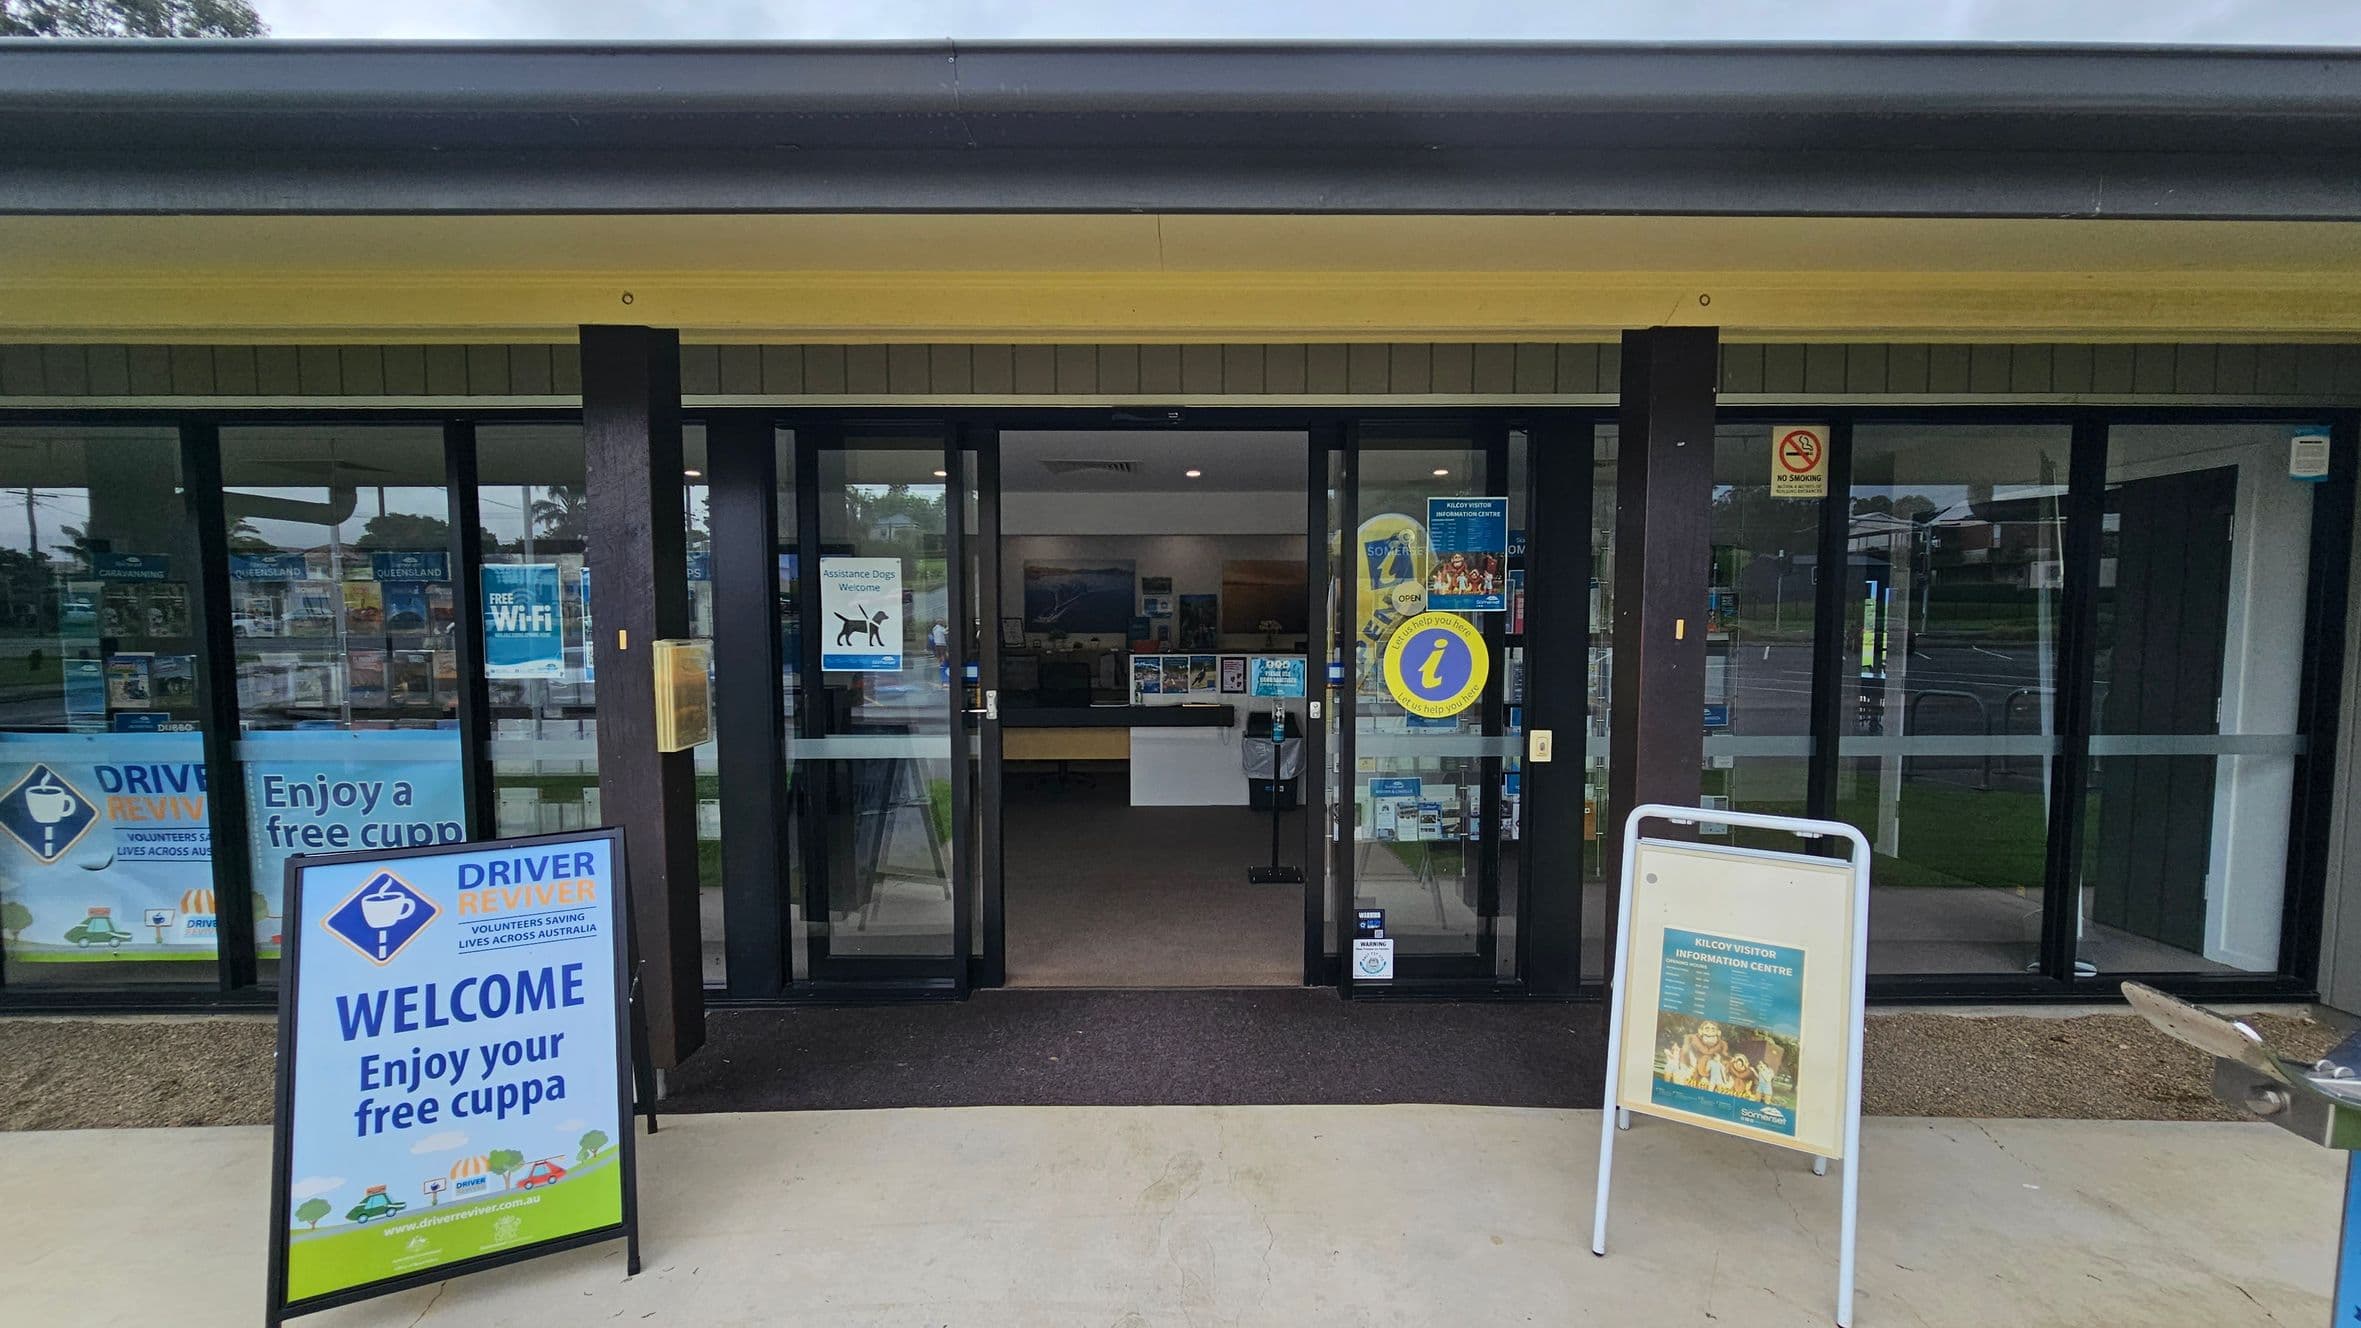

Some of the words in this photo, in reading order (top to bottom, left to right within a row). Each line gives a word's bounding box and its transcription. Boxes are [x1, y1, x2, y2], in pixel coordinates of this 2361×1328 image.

[1789, 474, 1822, 482] SMOKING
[98, 569, 165, 578] CARAVANNING
[235, 567, 301, 579] QUEENSLAND
[377, 568, 442, 579] QUEENSLAND
[823, 569, 871, 579] Assistance
[872, 570, 896, 580] Dogs
[489, 592, 514, 605] FREE
[838, 583, 881, 592] Welcome
[1398, 594, 1422, 603] OPEN
[490, 605, 553, 632] Wi-Fi
[1391, 635, 1405, 650] Let
[1403, 627, 1413, 637] us
[1412, 616, 1433, 629] help
[1434, 617, 1451, 626] you
[1452, 620, 1472, 638] here
[1397, 691, 1412, 706] Let
[1411, 702, 1422, 711] us
[1423, 703, 1444, 714] help
[1445, 701, 1463, 713] you
[1462, 684, 1480, 702] here
[157, 723, 194, 732] DUBBO
[263, 774, 384, 817] Enjoy
[391, 780, 413, 807] a
[106, 795, 204, 821] REVIV
[127, 832, 198, 843] VOLUNTEERS
[266, 814, 349, 848] free
[360, 820, 463, 848] cupp
[117, 846, 146, 856] LIVES
[147, 846, 190, 857] ACROSS
[458, 851, 595, 890] DRIVER
[458, 878, 596, 917] REVIVER
[471, 917, 543, 935] VOLUNTEERS
[545, 912, 585, 926] SAVING
[458, 937, 490, 949] LIVES
[491, 931, 536, 945] ACROSS
[537, 923, 597, 939] AUSTRALIA
[1694, 937, 1733, 952] KILCOY
[1733, 944, 1777, 960] VISITOR
[1675, 948, 1749, 969] INFORMATION
[1750, 961, 1793, 977] CENTRE
[335, 962, 585, 1042] WELCOME
[360, 1046, 470, 1094] Enjoy
[479, 1032, 564, 1081] your
[354, 1097, 440, 1138] free
[451, 1074, 566, 1121] cuppa
[1740, 1107, 1787, 1126] Somerset
[456, 1177, 487, 1190] DRIVER
[383, 1193, 542, 1238] www.driverreviver.com.au
